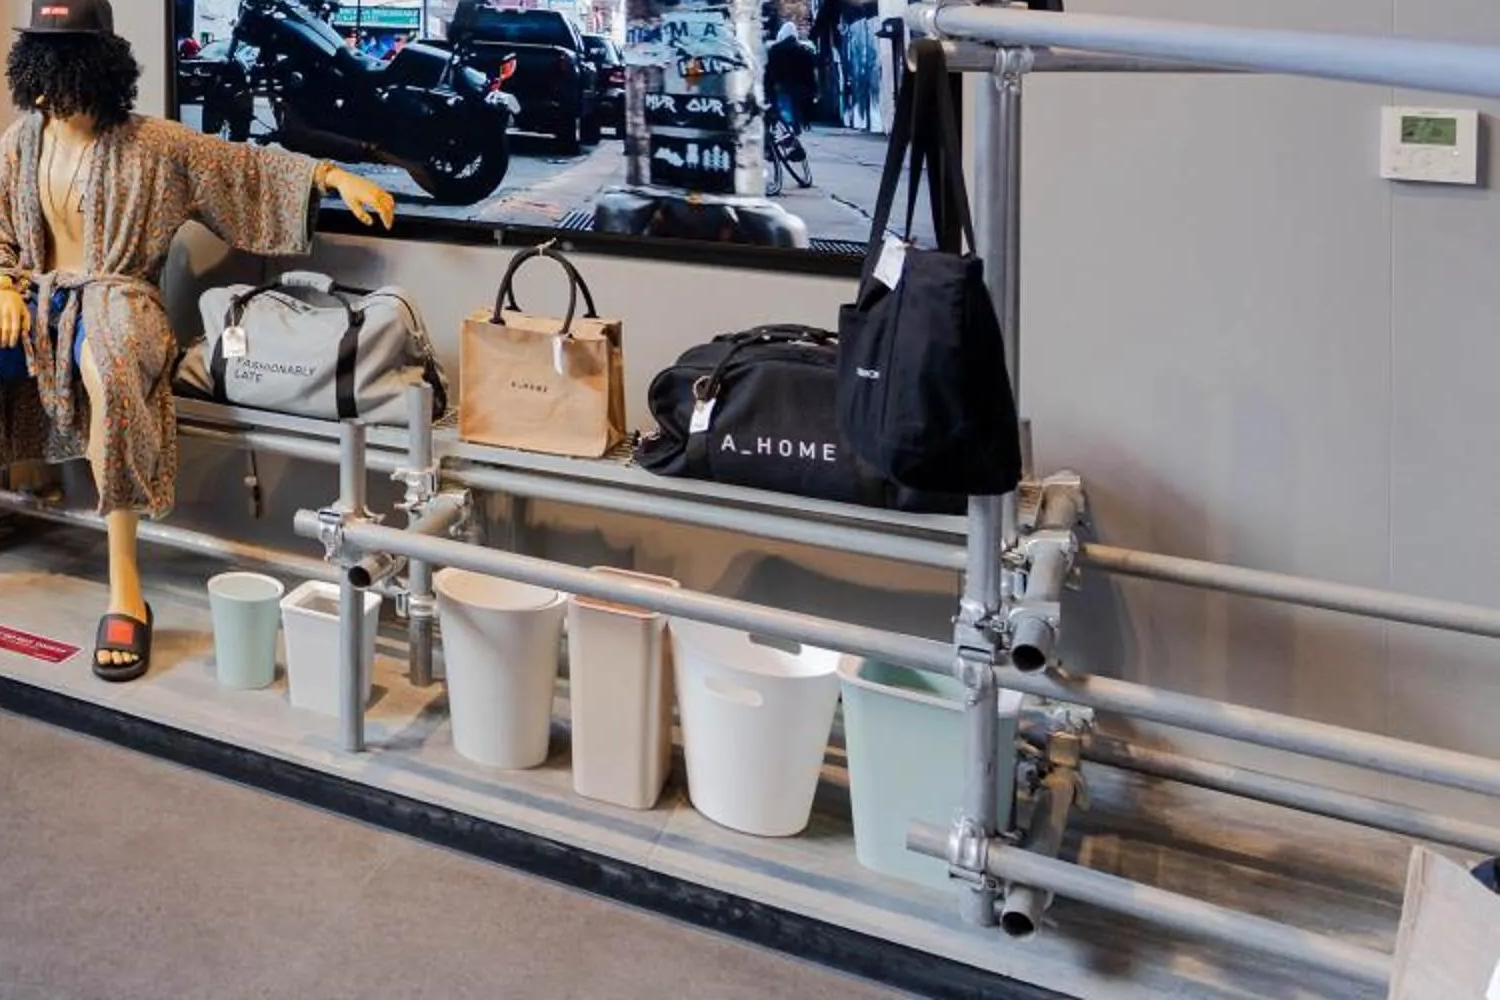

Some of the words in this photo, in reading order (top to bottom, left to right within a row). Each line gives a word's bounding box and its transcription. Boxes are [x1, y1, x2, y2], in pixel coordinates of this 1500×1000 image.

[234, 369, 263, 383] LATE
[235, 357, 316, 377] FASHIONABLY
[720, 433, 837, 461] A_HOME
